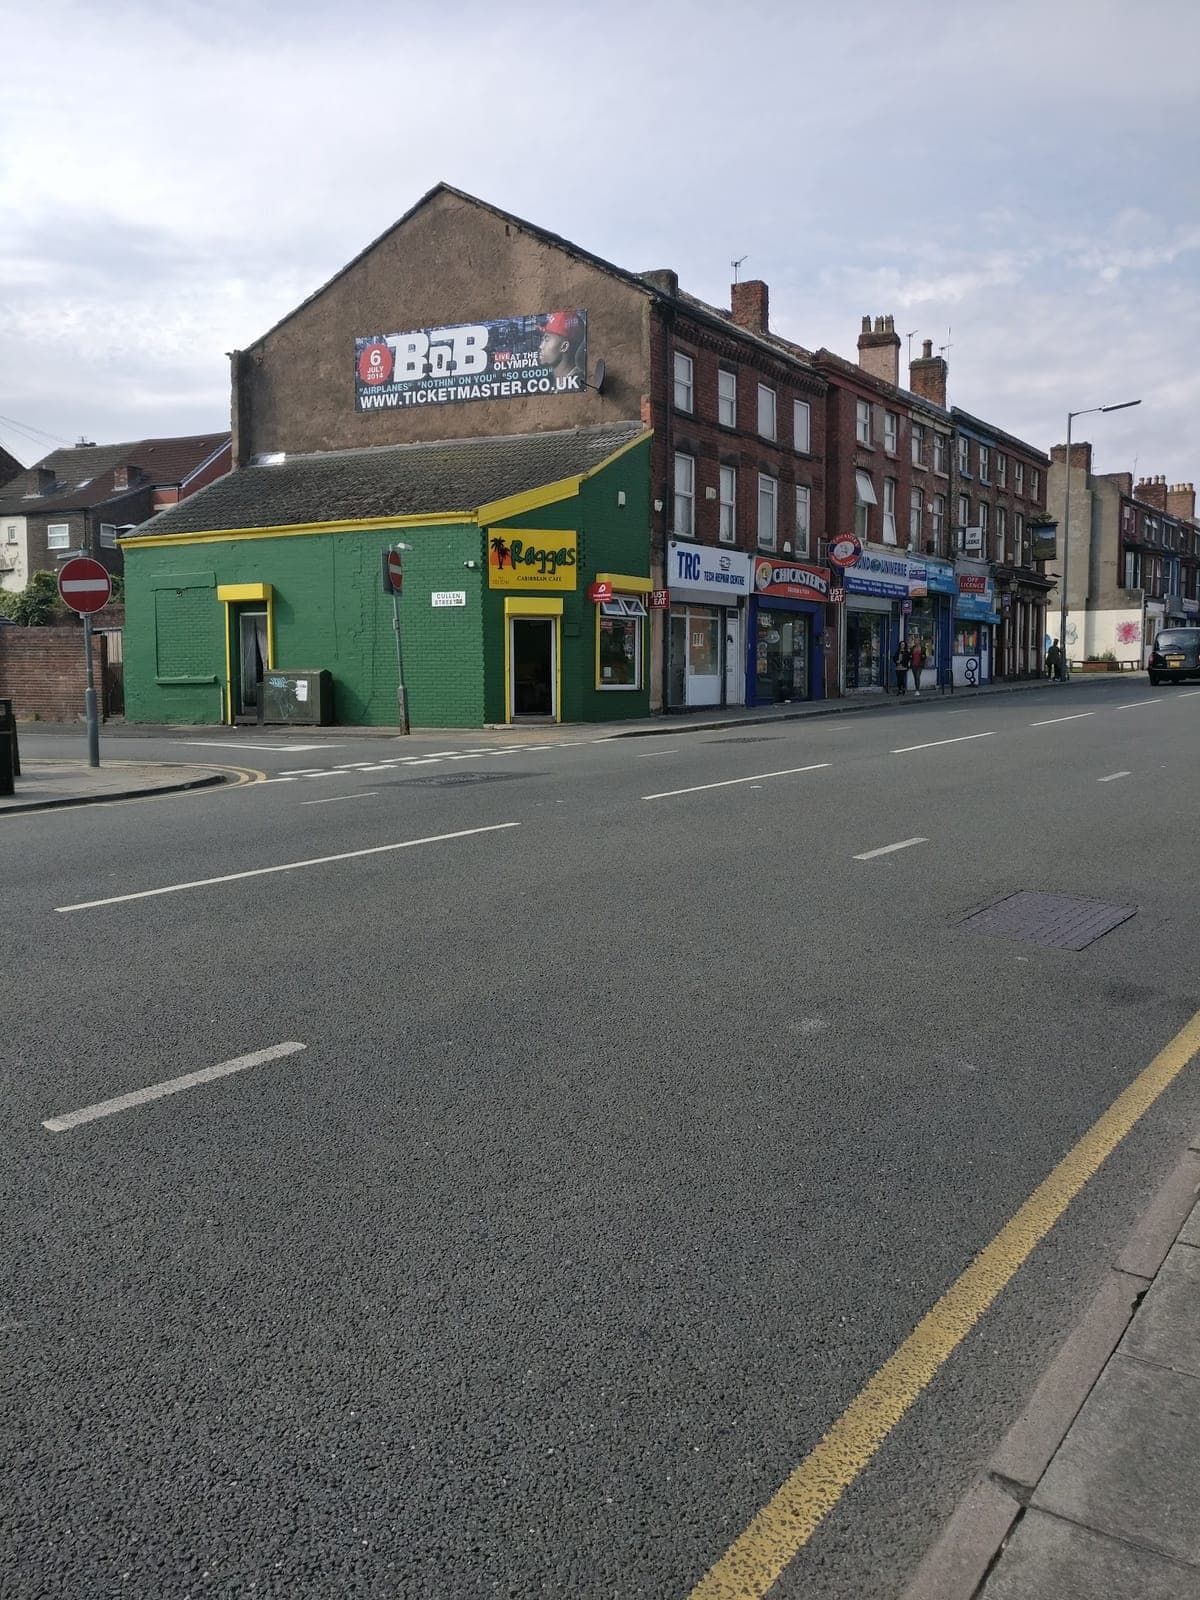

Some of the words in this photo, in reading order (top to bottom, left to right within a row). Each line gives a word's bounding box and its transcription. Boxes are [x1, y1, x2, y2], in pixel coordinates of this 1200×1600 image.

[370, 350, 381, 366] 6
[494, 352, 511, 361] LIVE
[510, 353, 520, 361] AT
[522, 351, 539, 359] THE
[367, 365, 384, 374] JULY
[493, 358, 539, 371] OLYMPIA
[459, 376, 470, 385] ON
[360, 375, 580, 409] WWW.TICKETMASTER.CO.UK
[509, 540, 577, 575] Raggas
[677, 550, 701, 580] TRC
[703, 571, 715, 582] TECH
[715, 572, 730, 584] REPAIR
[730, 574, 745, 586] CENTRE
[830, 594, 843, 602] EAT
